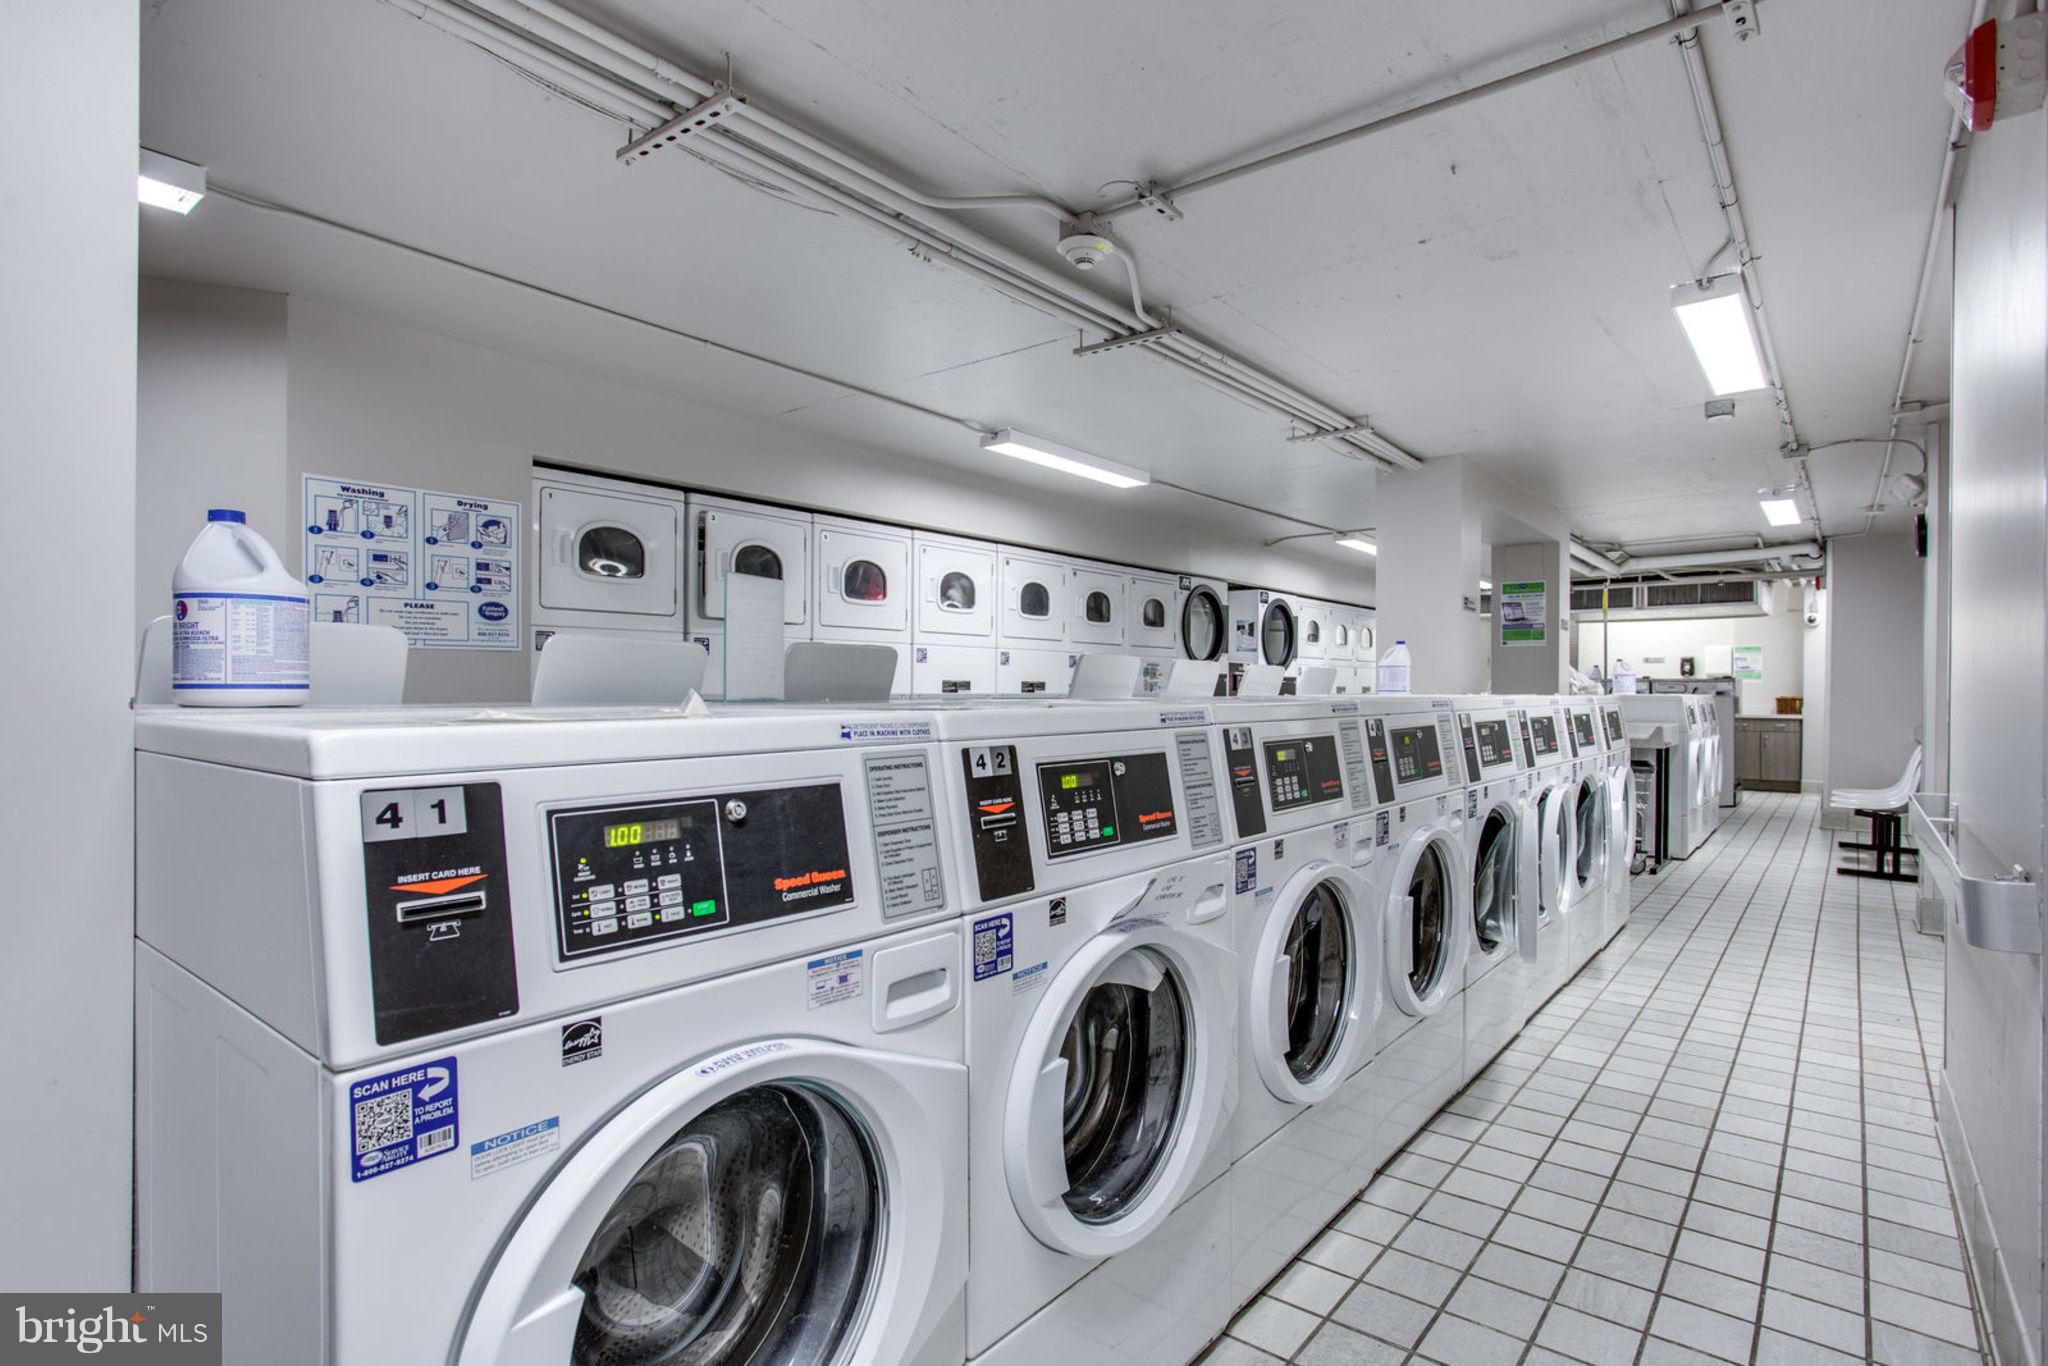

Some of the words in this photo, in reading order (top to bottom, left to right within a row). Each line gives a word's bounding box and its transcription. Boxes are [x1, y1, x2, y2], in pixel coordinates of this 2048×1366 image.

[340, 485, 385, 498] Washing
[457, 500, 488, 511] Drying
[869, 764, 892, 772] OPERATING
[902, 824, 931, 833] INSTRUCTIONS
[397, 873, 430, 884] INSERT
[431, 869, 457, 880] CARD
[457, 866, 481, 877] HERE
[774, 873, 810, 891] Speed
[811, 869, 846, 884] Queen
[782, 886, 819, 902] Commercial
[820, 883, 842, 894] Washer
[353, 1079, 389, 1098] SCAN
[391, 1069, 426, 1089] HERE
[414, 1107, 424, 1116] TO
[425, 1097, 453, 1113] REPORT
[414, 1117, 420, 1125] A
[484, 1121, 550, 1150] NOTICE
